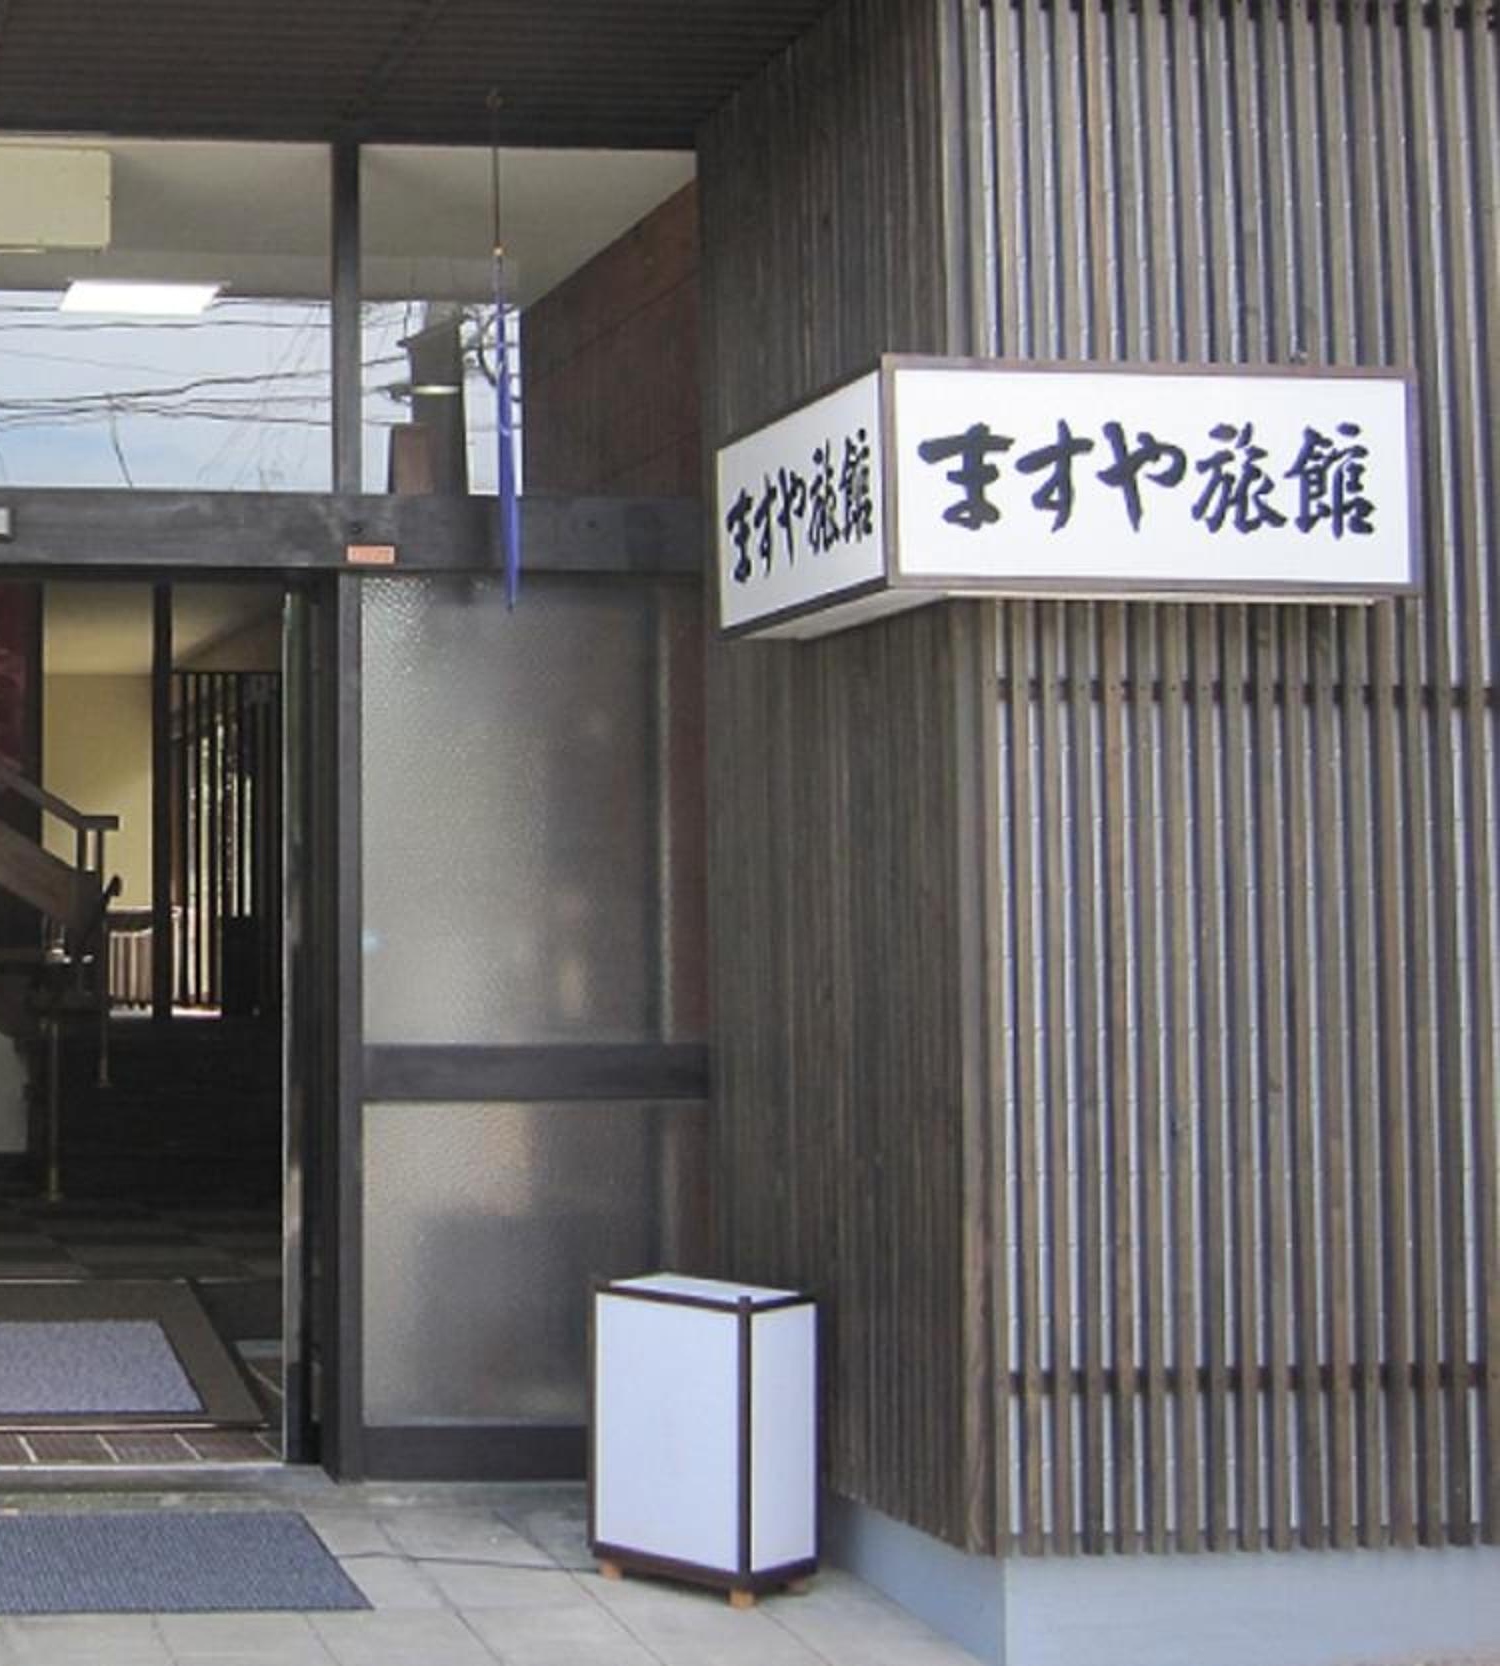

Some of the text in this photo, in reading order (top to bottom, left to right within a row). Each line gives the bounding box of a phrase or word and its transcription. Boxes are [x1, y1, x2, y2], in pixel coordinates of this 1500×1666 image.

[726, 427, 875, 583] ますや旅館
[918, 419, 1377, 539] ますや旅館
